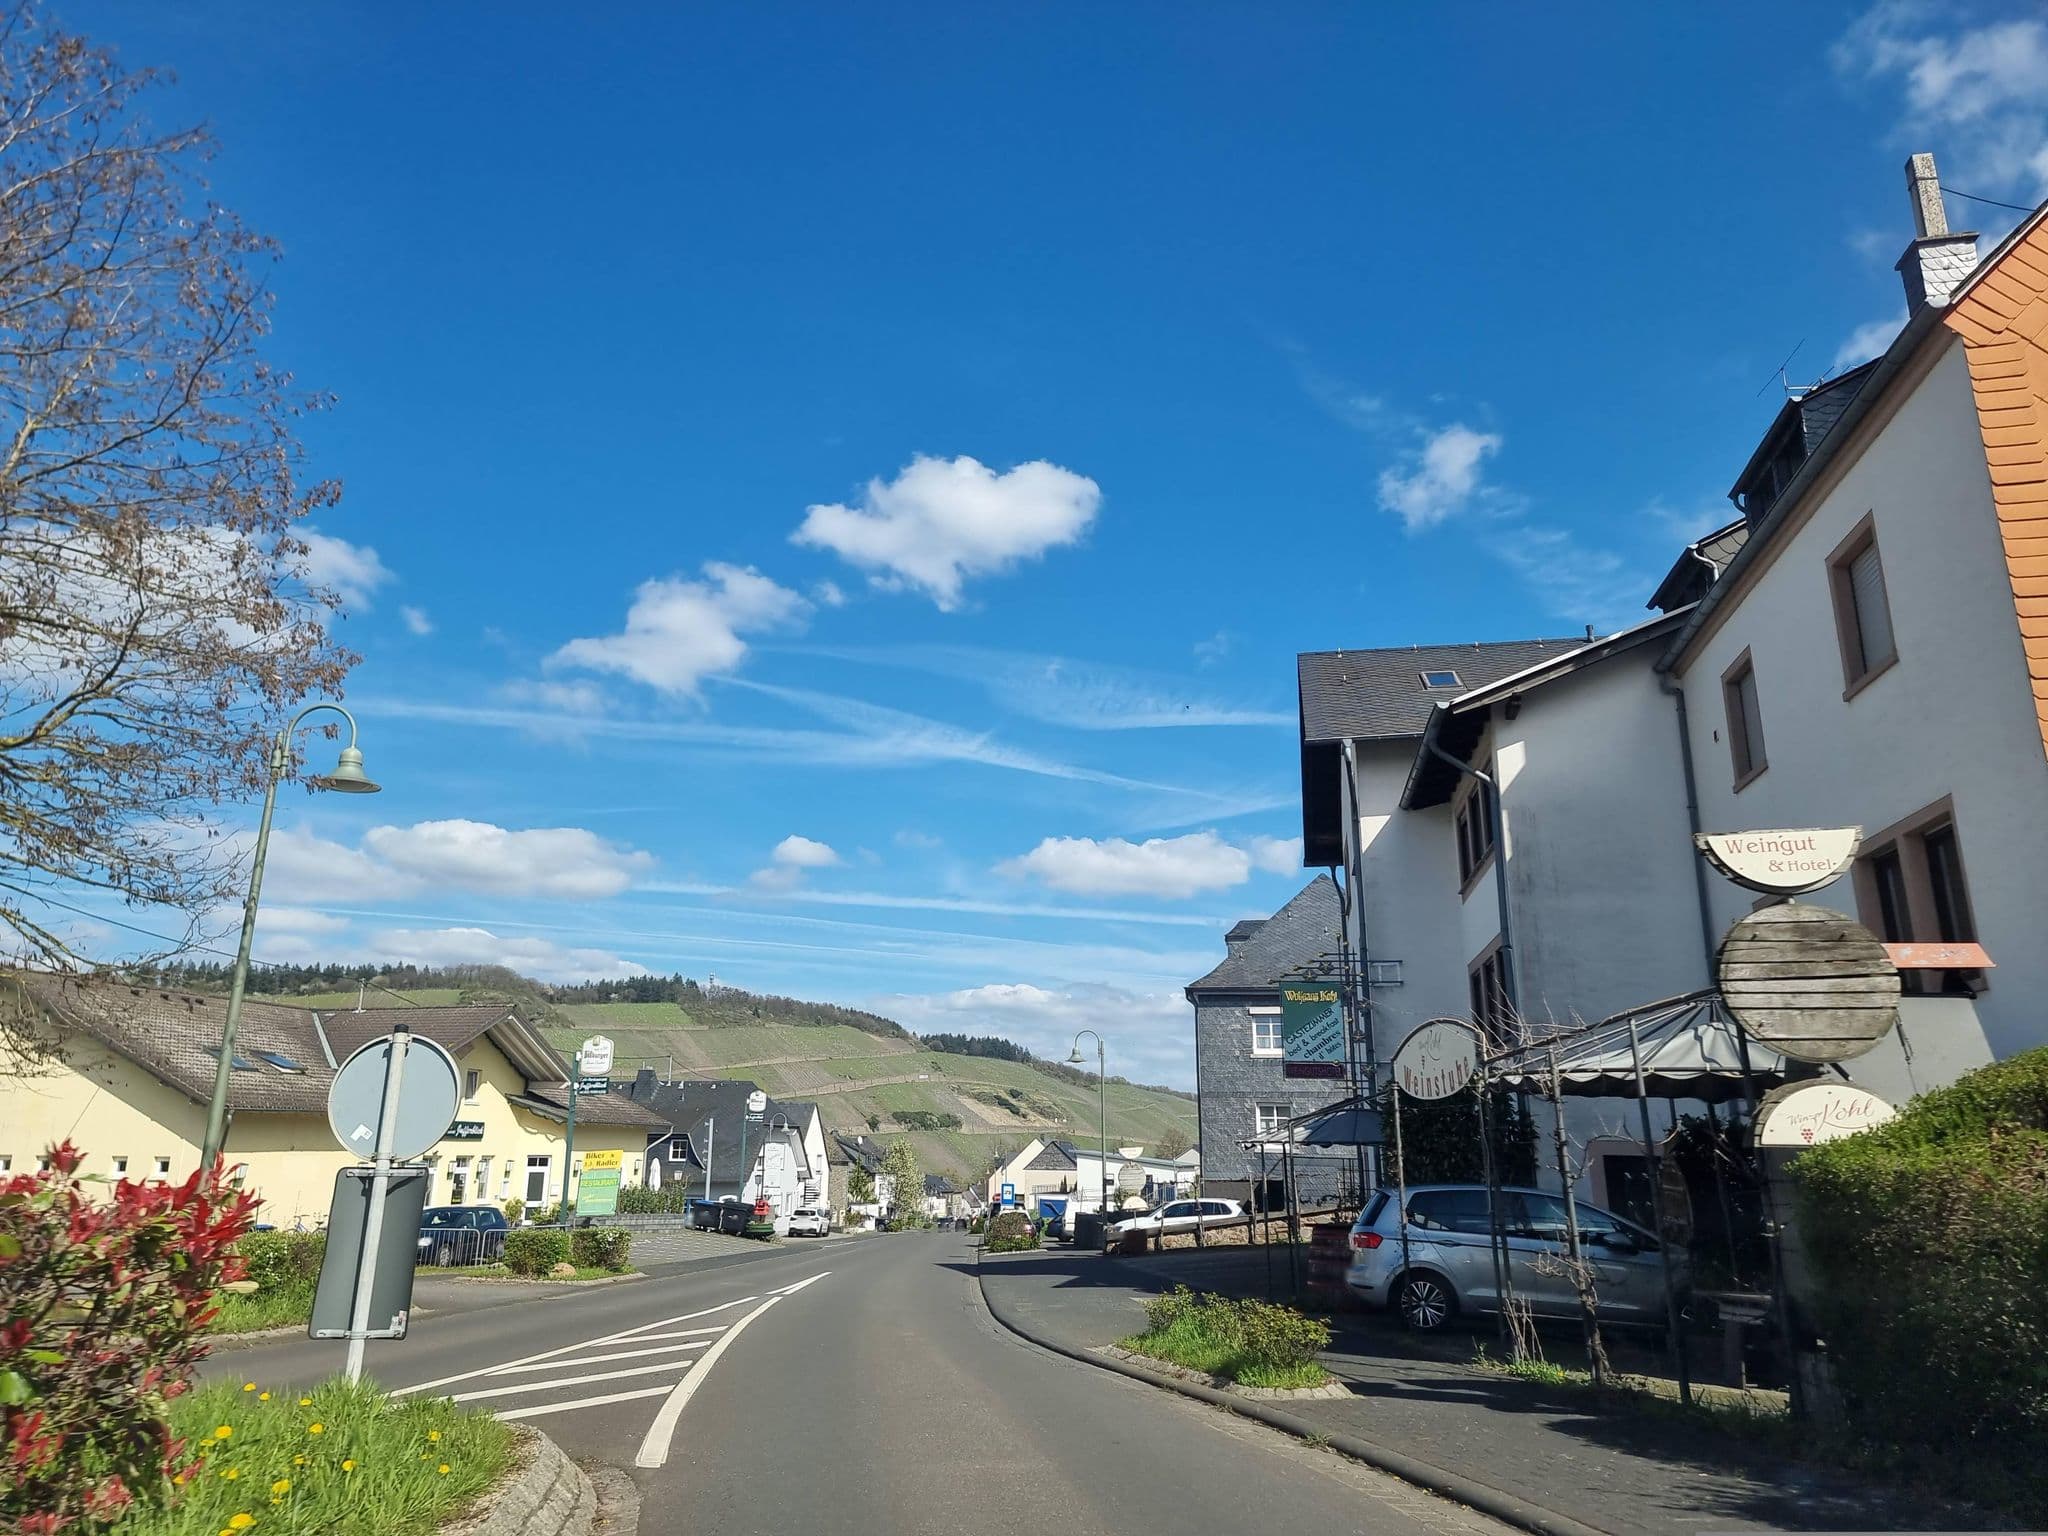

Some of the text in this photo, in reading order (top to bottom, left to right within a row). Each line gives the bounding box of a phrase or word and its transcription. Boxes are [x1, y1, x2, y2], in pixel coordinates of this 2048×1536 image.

[1724, 836, 1817, 856] Weingut
[1768, 858, 1832, 872] & Hotel
[1284, 990, 1319, 1004] Wolfgang
[1287, 1018, 1340, 1057] bed & breakfast
[1303, 1031, 1341, 1059] chambres
[1403, 1056, 1469, 1097] Weinstube
[1818, 1098, 1874, 1130] Kohl
